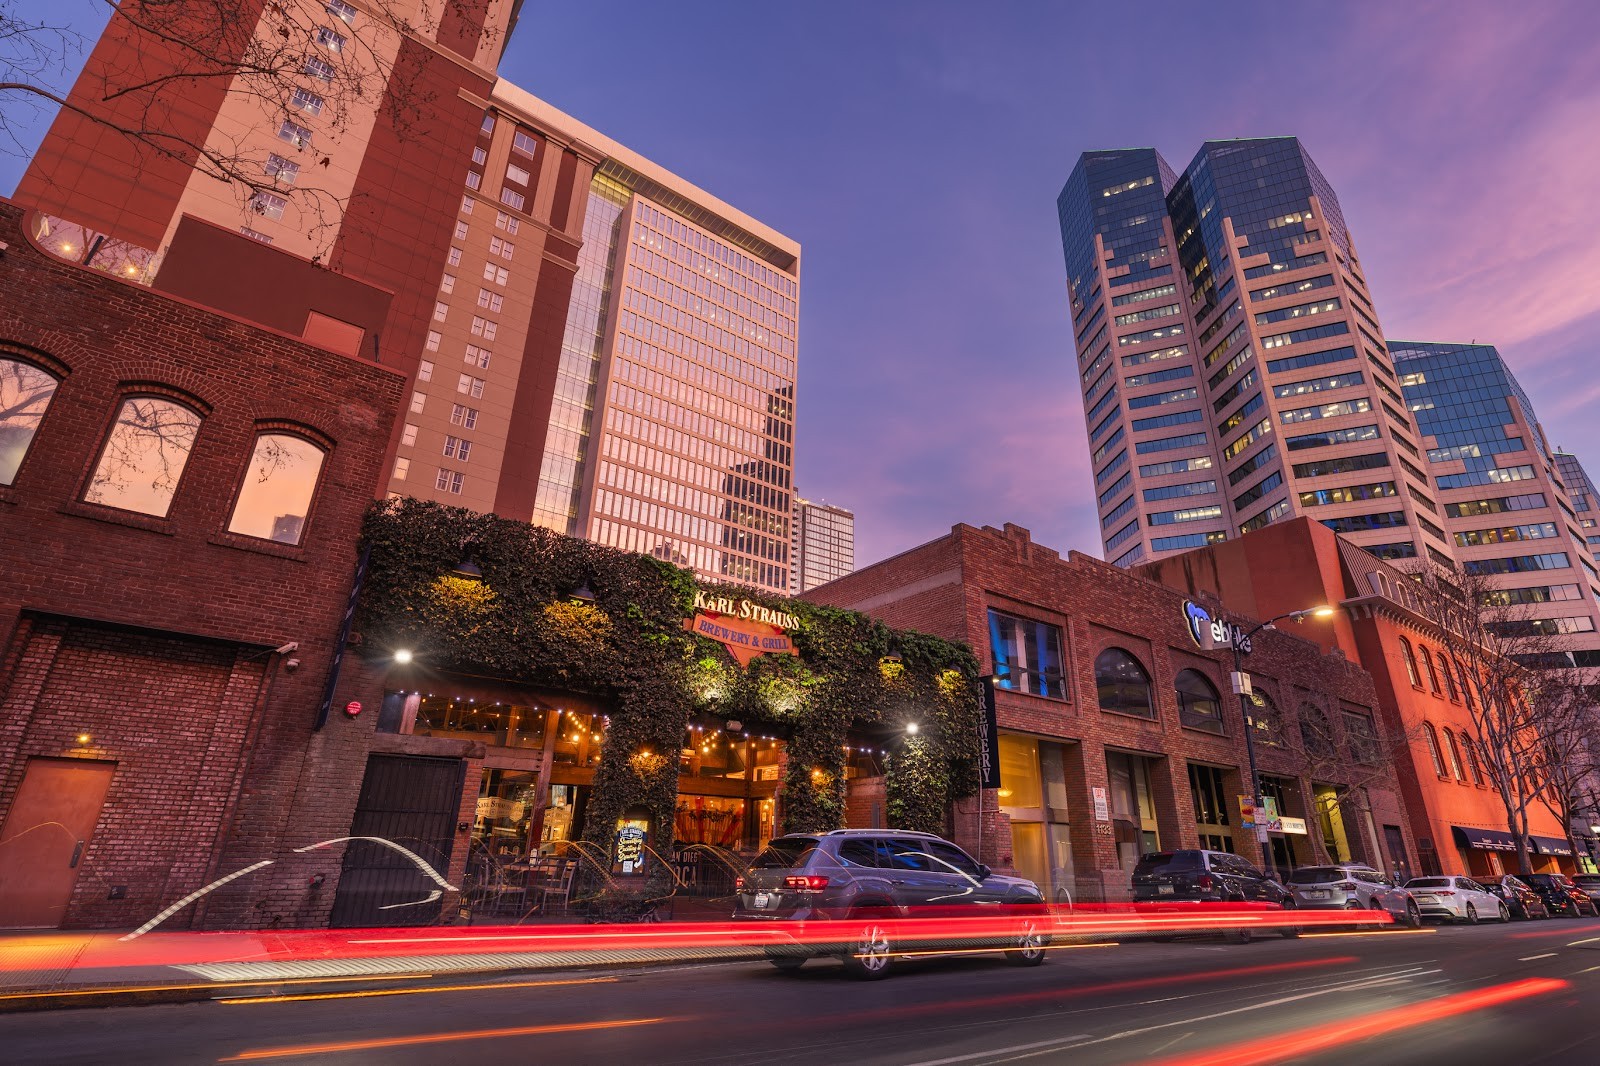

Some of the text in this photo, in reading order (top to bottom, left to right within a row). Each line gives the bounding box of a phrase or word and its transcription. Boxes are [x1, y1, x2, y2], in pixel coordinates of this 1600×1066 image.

[693, 590, 800, 631] KARL STRAUSS
[699, 619, 789, 650] BREWERY & GRILL
[977, 681, 992, 783] BREWERY
